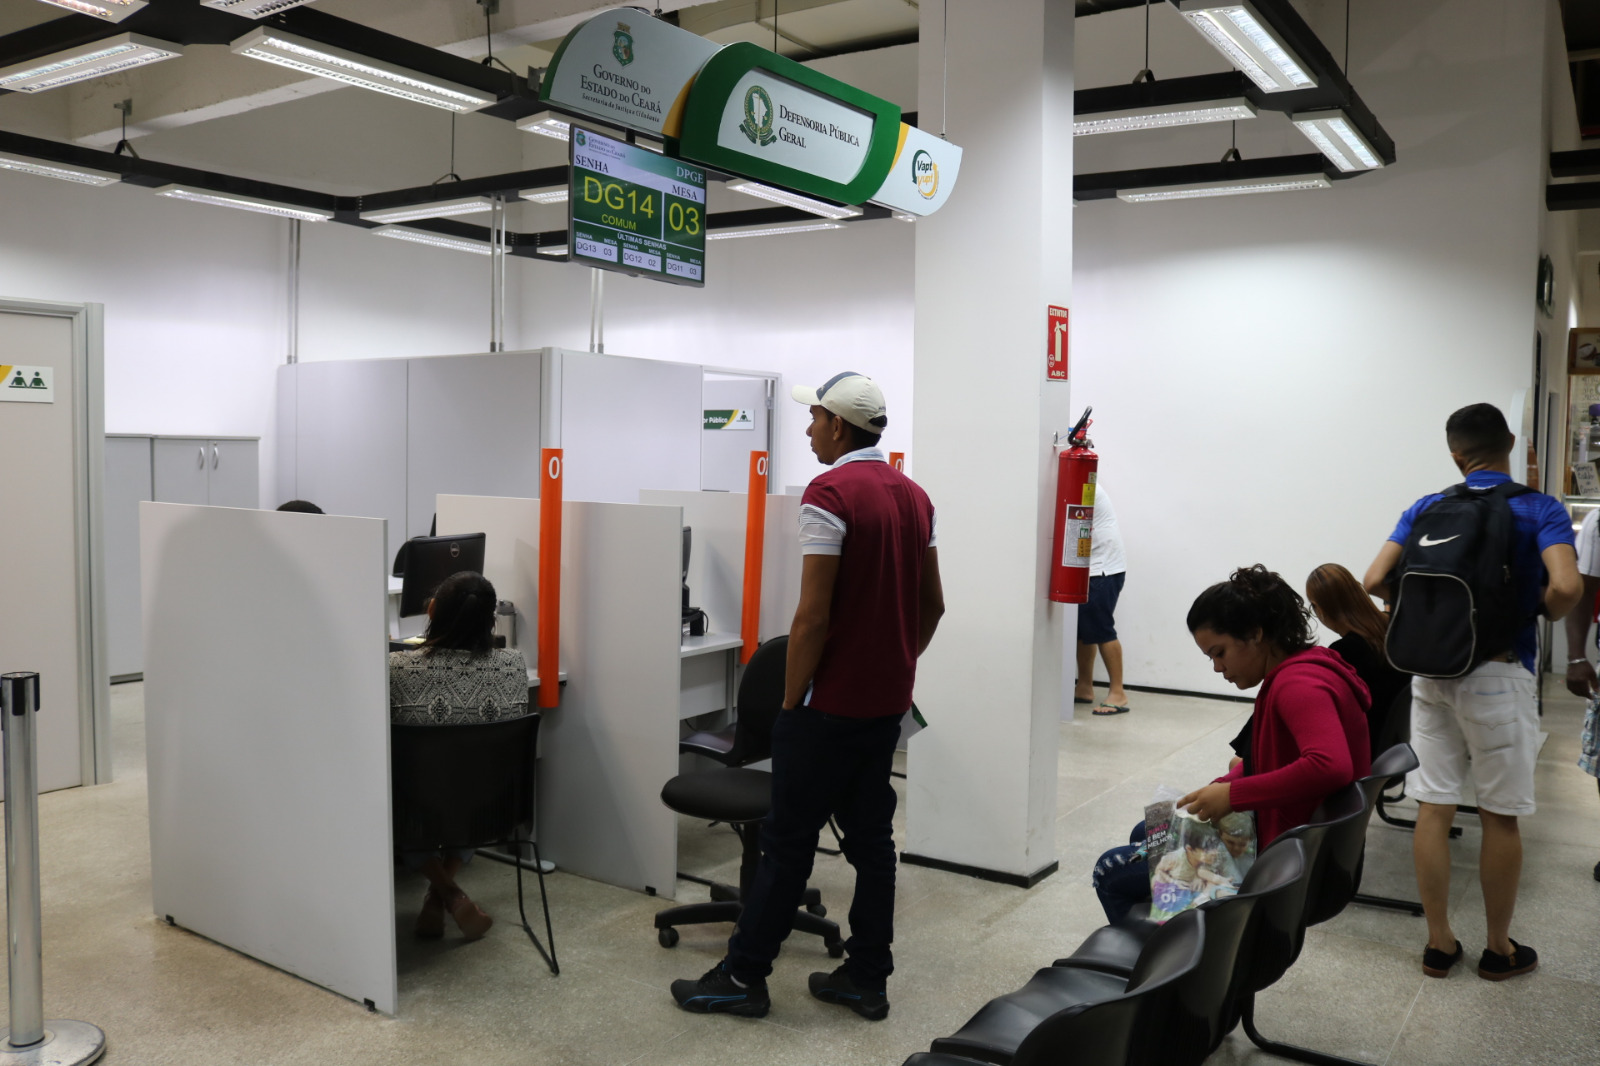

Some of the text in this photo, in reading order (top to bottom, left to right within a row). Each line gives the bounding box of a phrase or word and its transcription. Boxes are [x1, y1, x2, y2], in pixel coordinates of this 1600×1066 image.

[593, 64, 651, 95] GOVERNO DO
[581, 75, 662, 114] ESTADO DO CEARÁ
[582, 93, 607, 106] Secretaria
[779, 104, 860, 147] DEFENSORIA PÚBLICA
[778, 126, 807, 149] GERAL
[576, 154, 609, 173] SENHA
[917, 160, 933, 174] Vapt
[676, 166, 704, 184] DPGE
[584, 175, 654, 219] DG14
[672, 184, 698, 201] MESA
[601, 213, 637, 231] COMUM
[669, 202, 700, 235] 03
[576, 241, 612, 256] DG13 03
[617, 231, 667, 251] ÚLTIMAS SENHAS
[623, 252, 657, 267] DG12 02
[667, 262, 697, 275] DG11 03
[1152, 830, 1167, 841] BEM
